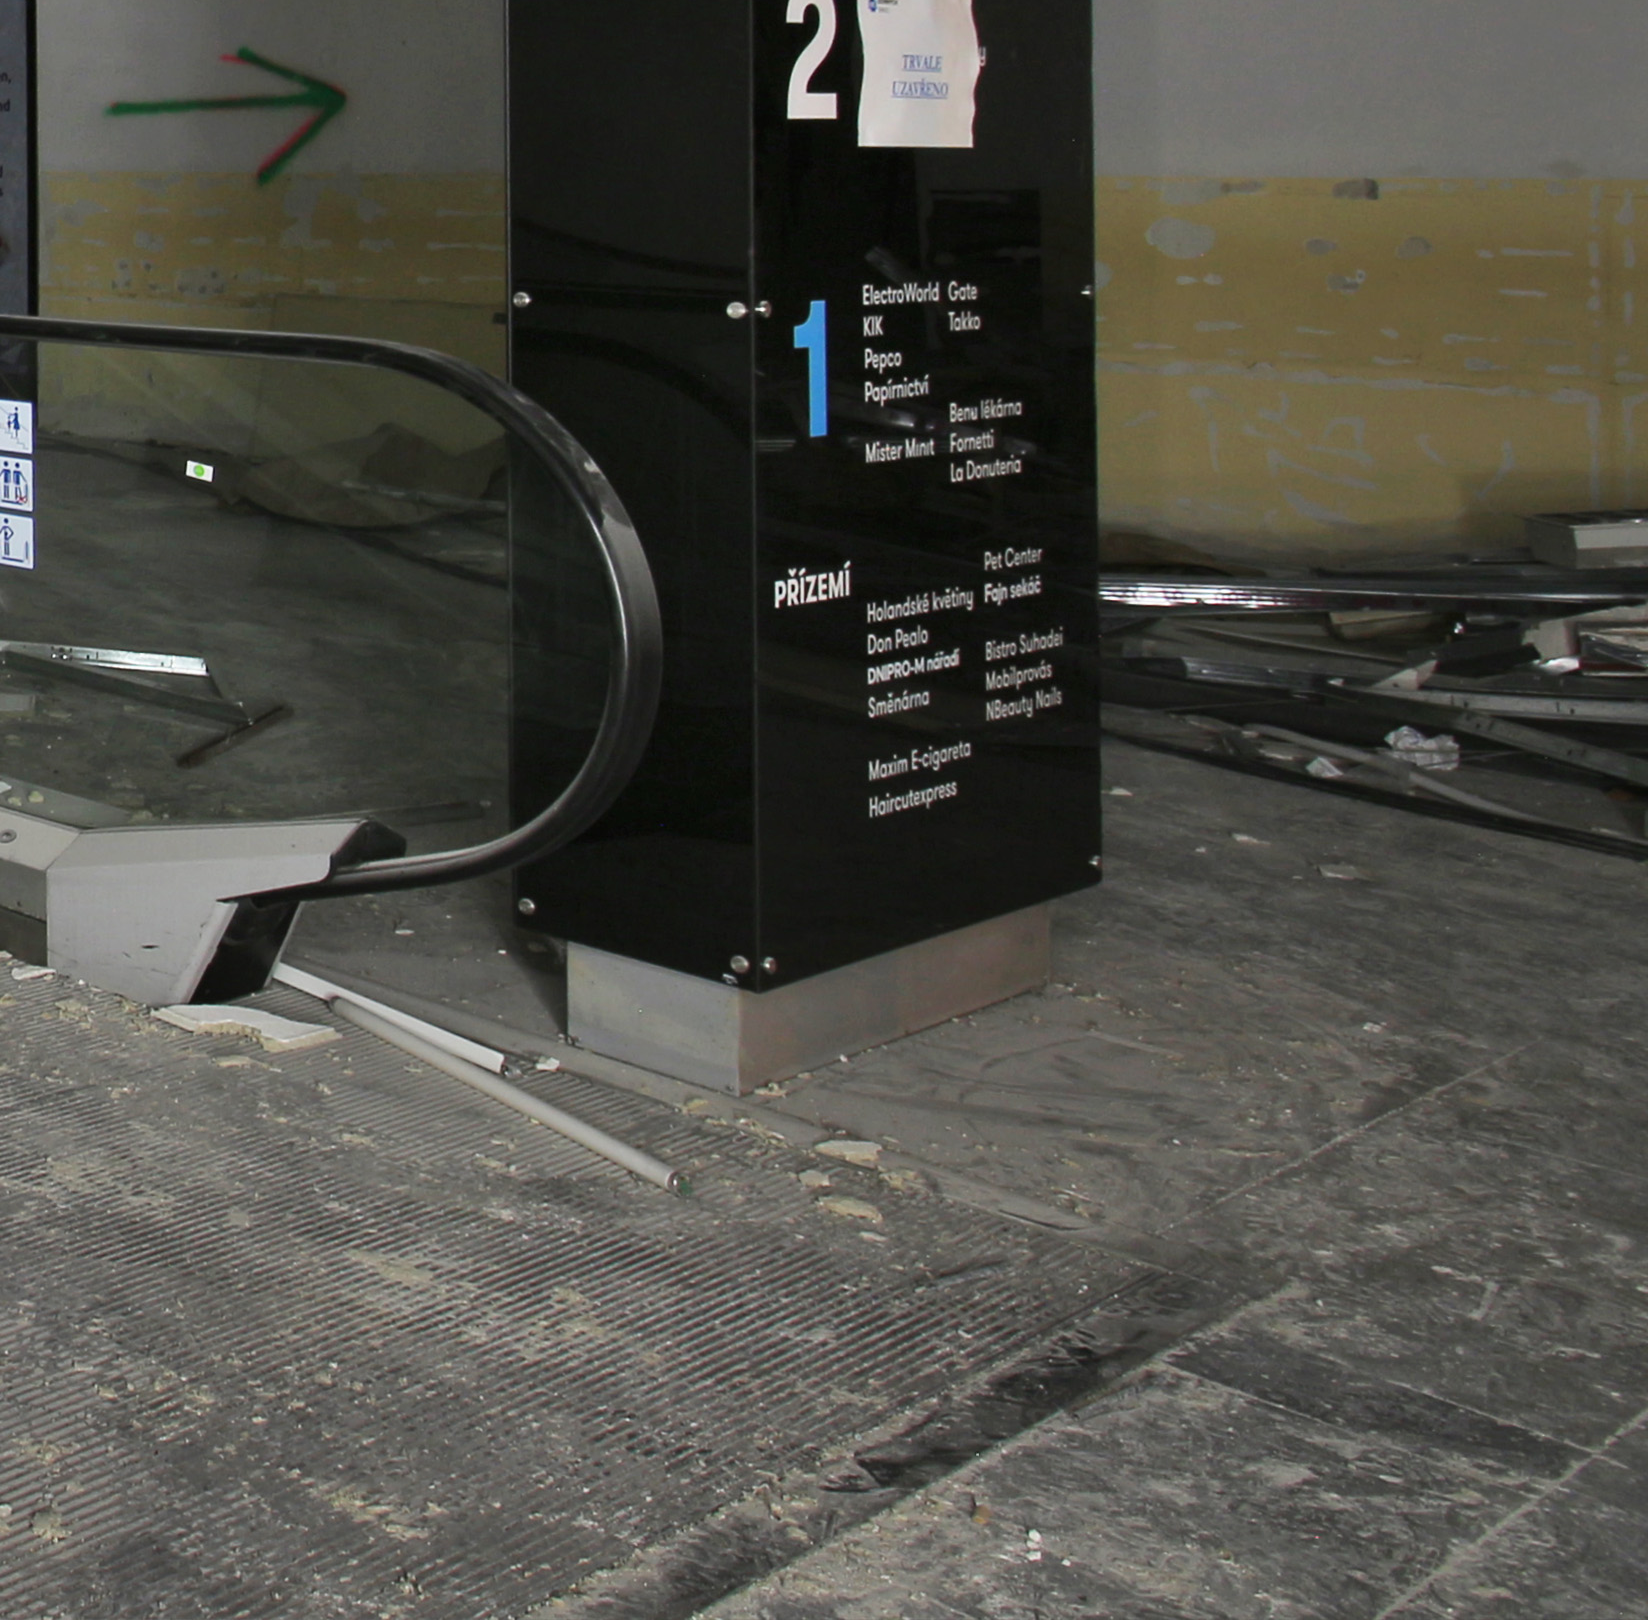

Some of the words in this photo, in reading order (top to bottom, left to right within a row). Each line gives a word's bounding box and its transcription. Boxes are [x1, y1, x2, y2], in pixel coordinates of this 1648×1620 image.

[902, 54, 943, 70] TRVALE
[891, 78, 949, 97] UZAVŘENO
[862, 282, 940, 305] ElectroWorld
[948, 281, 978, 301] Gate
[863, 315, 884, 337] KIK
[948, 311, 981, 331] Takko
[793, 300, 828, 438] 1
[864, 348, 902, 374] Pepco
[864, 374, 930, 407] Papírnictví
[949, 402, 978, 423] Benu
[980, 398, 1022, 420] lékárna
[865, 441, 902, 463] Mister
[949, 429, 994, 453] Fornetti
[950, 462, 963, 482] La
[966, 454, 1022, 481] Donuteria
[984, 551, 1003, 571] Pet
[1005, 546, 1043, 568] Center
[774, 561, 851, 609] PŘÍZEMÍ
[984, 582, 1008, 607] Fajn
[1010, 575, 1042, 599] sekáč
[867, 593, 929, 624] Holandské
[932, 586, 974, 611] květiny
[867, 633, 892, 656] Don
[895, 625, 929, 650] Pealo
[985, 640, 1017, 662] Bistro
[867, 656, 925, 686] DNIPRO-M
[927, 647, 960, 673] nářadí
[868, 690, 930, 719] Směnárna
[986, 696, 1033, 722] NBeauty
[1036, 686, 1062, 710] Nails
[868, 755, 908, 782] Maxim
[911, 741, 972, 772] E-cigareta
[869, 781, 958, 818] Haircutexpress
